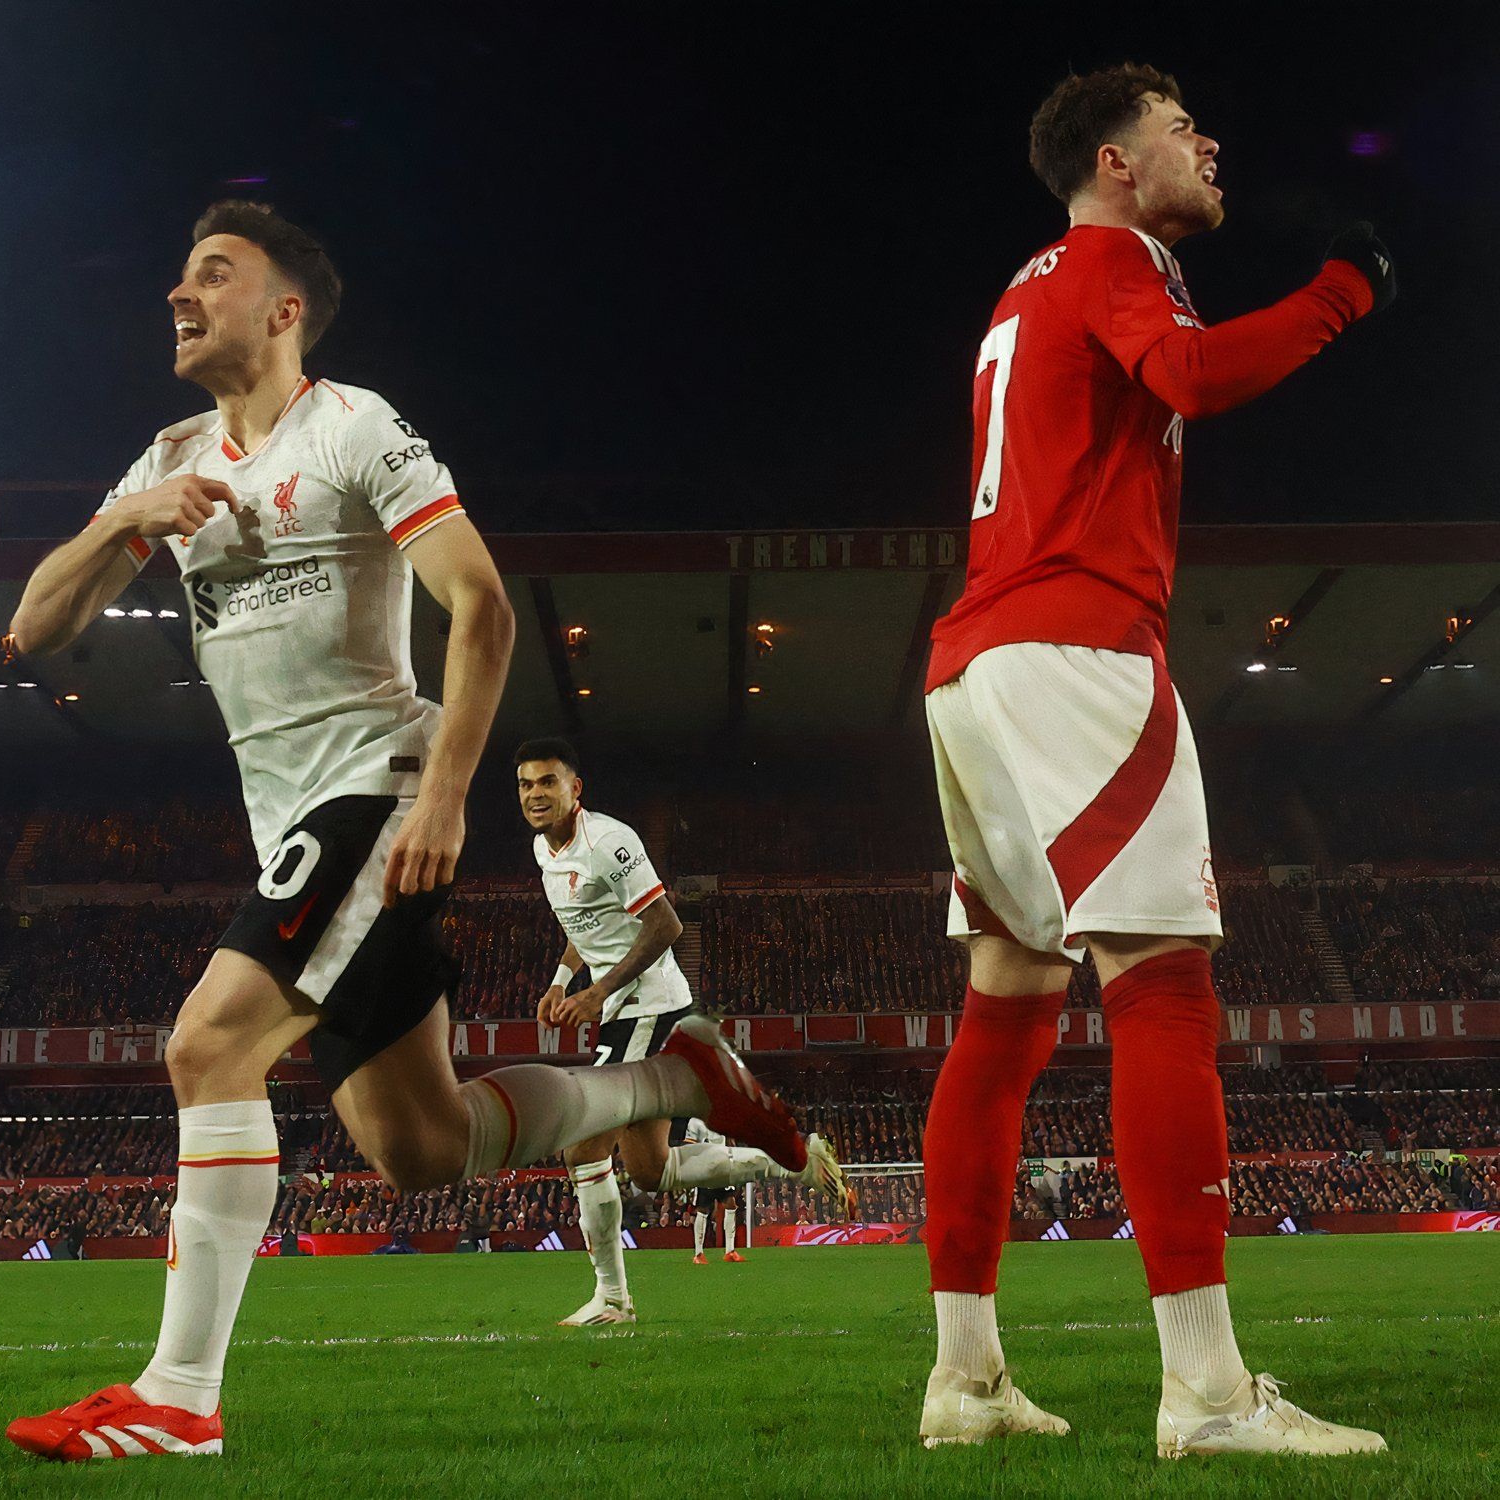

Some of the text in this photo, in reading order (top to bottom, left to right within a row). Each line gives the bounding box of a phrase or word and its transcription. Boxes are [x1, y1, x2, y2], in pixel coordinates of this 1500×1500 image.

[972, 314, 1020, 520] 7
[274, 520, 305, 539] LFC
[726, 534, 956, 568] TRENT END
[227, 571, 332, 617] chartered
[88, 1029, 172, 1062] GAR
[453, 1024, 499, 1056] AT
[905, 1014, 953, 1048] WI
[1057, 1012, 1103, 1045] PR
[1228, 1008, 1316, 1041] WAS
[1353, 1004, 1467, 1038] MADE
